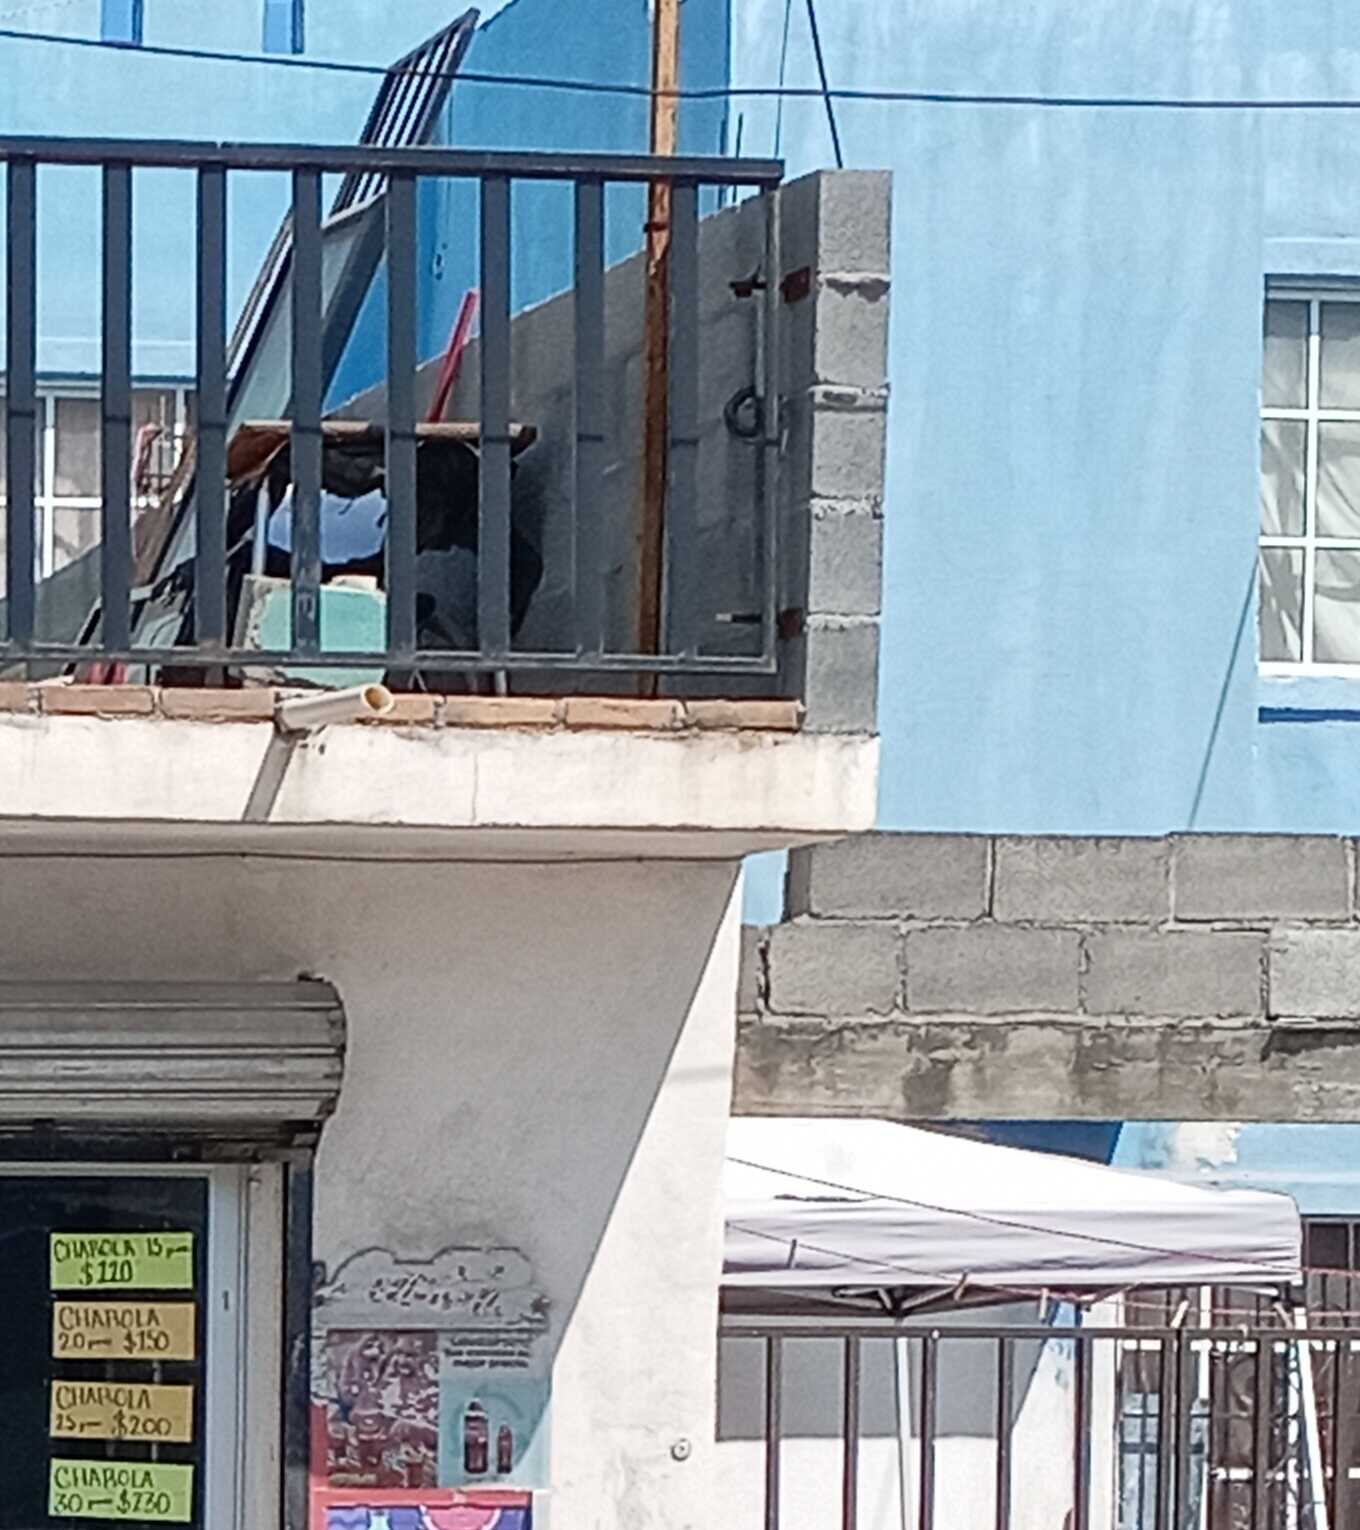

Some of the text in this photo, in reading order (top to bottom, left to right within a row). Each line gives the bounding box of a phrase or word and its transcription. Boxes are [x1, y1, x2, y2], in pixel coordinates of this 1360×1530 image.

[54, 1239, 136, 1262] CHAROLA
[59, 1306, 160, 1331] CHAROLA
[58, 1332, 85, 1351] 20
[56, 1386, 150, 1410] CHAROLA
[112, 1407, 172, 1434] $200
[54, 1466, 153, 1489] CHAROLA
